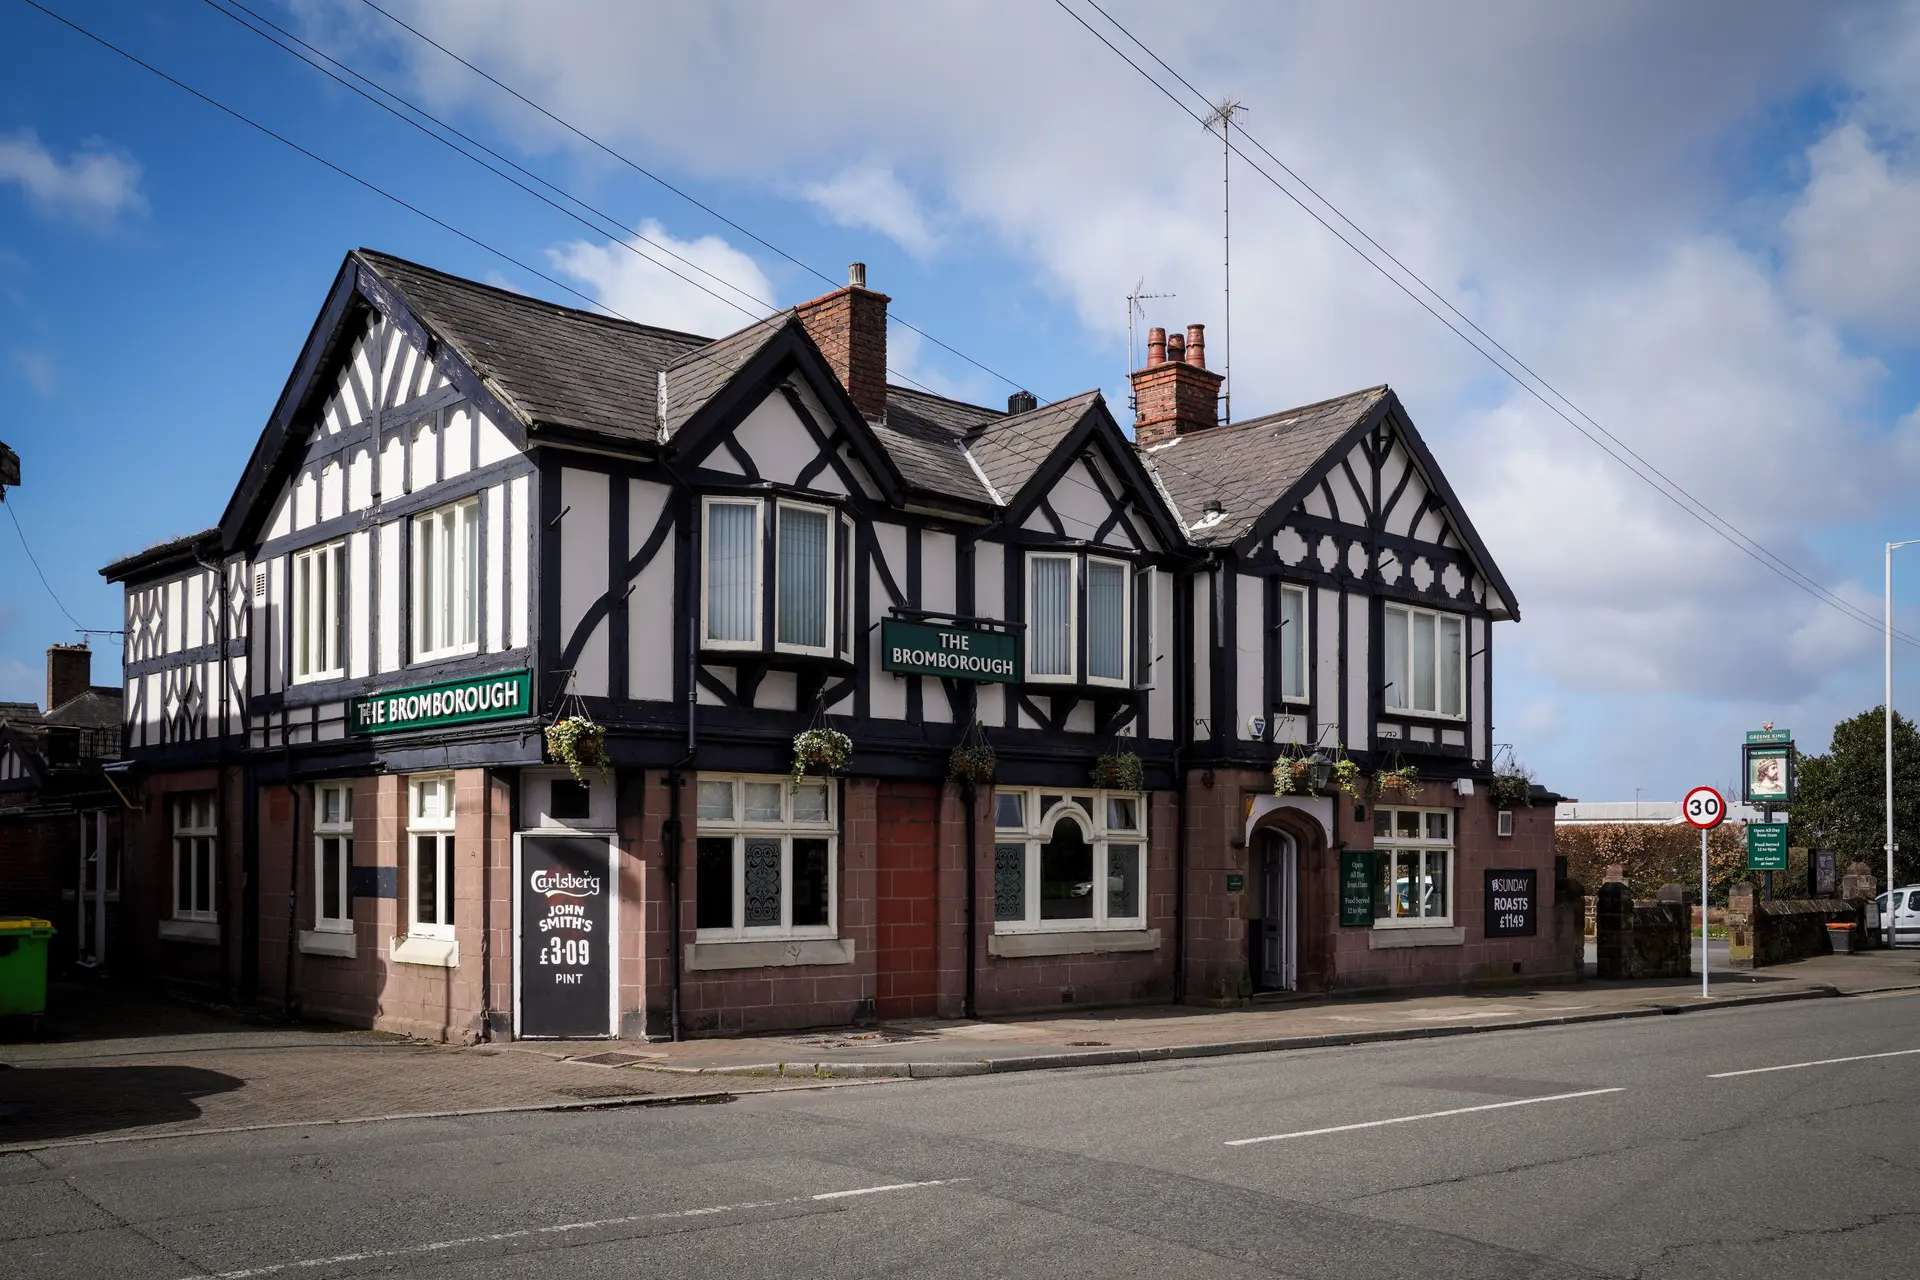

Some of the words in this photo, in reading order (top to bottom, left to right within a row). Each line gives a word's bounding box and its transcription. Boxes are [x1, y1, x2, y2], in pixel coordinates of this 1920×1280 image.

[939, 633, 969, 650] THE
[893, 648, 1013, 675] BROMBOROUGH
[357, 700, 385, 725] THE
[389, 680, 518, 722] BROMBOROUGH
[1690, 798, 1718, 816] 30
[1351, 861, 1364, 869] Open
[1357, 871, 1365, 879] Day
[531, 870, 600, 898] Carlsberg
[1498, 878, 1529, 892] SUNDAY
[1356, 896, 1370, 904] Served
[1494, 897, 1528, 911] ROASTS
[548, 904, 584, 917] JOHN
[539, 916, 593, 932] SMITH'S
[1499, 913, 1524, 928] £11.49
[555, 973, 583, 984] PINT
